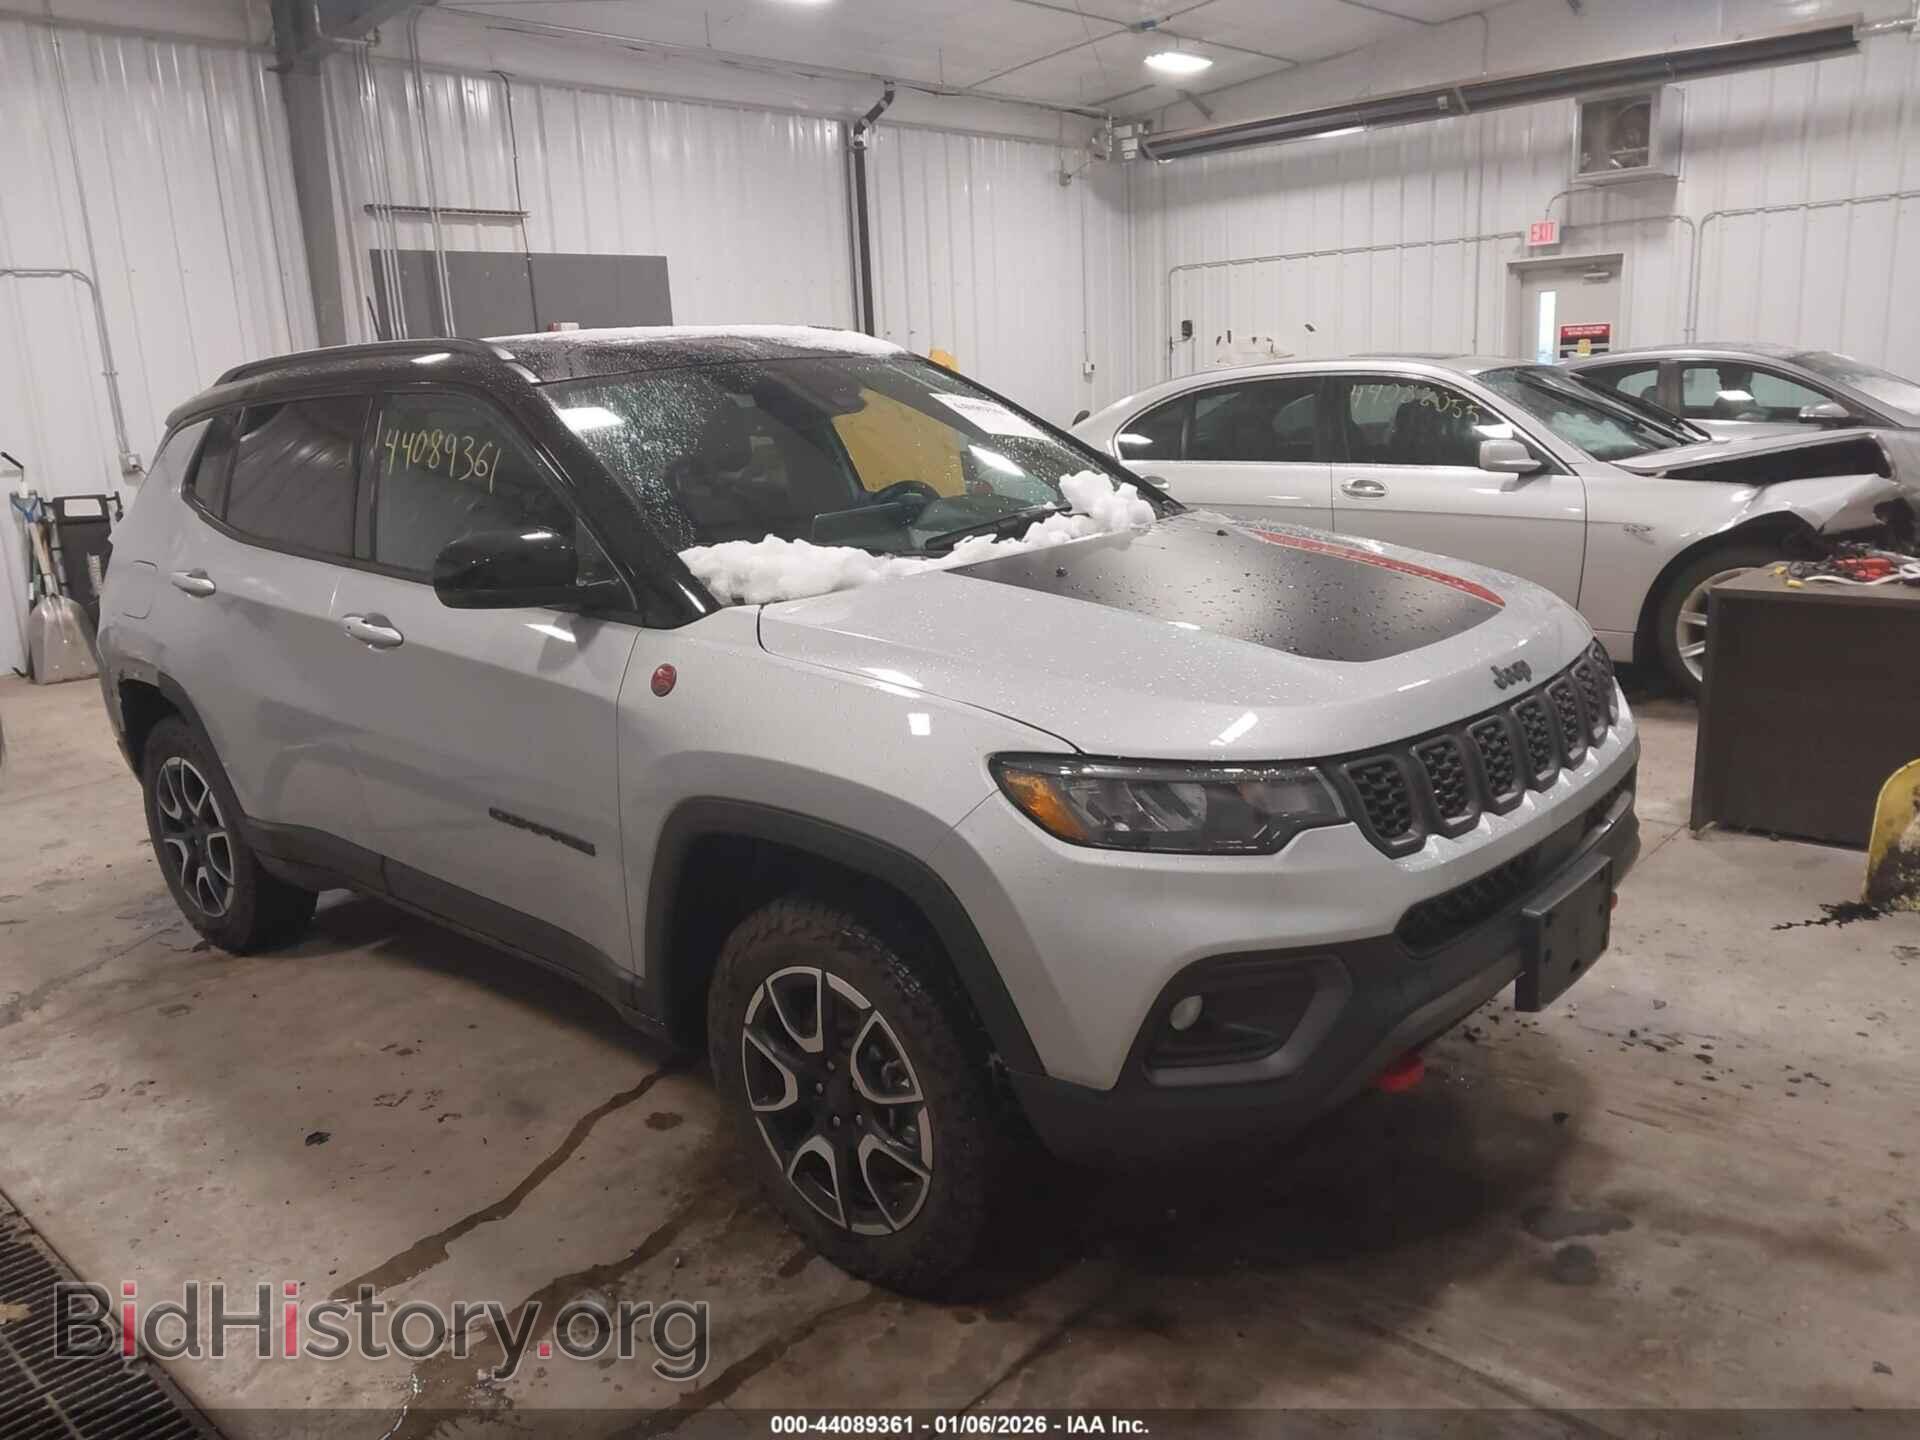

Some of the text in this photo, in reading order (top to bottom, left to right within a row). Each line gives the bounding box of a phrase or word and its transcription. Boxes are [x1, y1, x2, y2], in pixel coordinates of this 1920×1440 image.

[1531, 222, 1555, 242] EXIT
[385, 428, 501, 494] 44089361
[1490, 659, 1532, 689] Jeep
